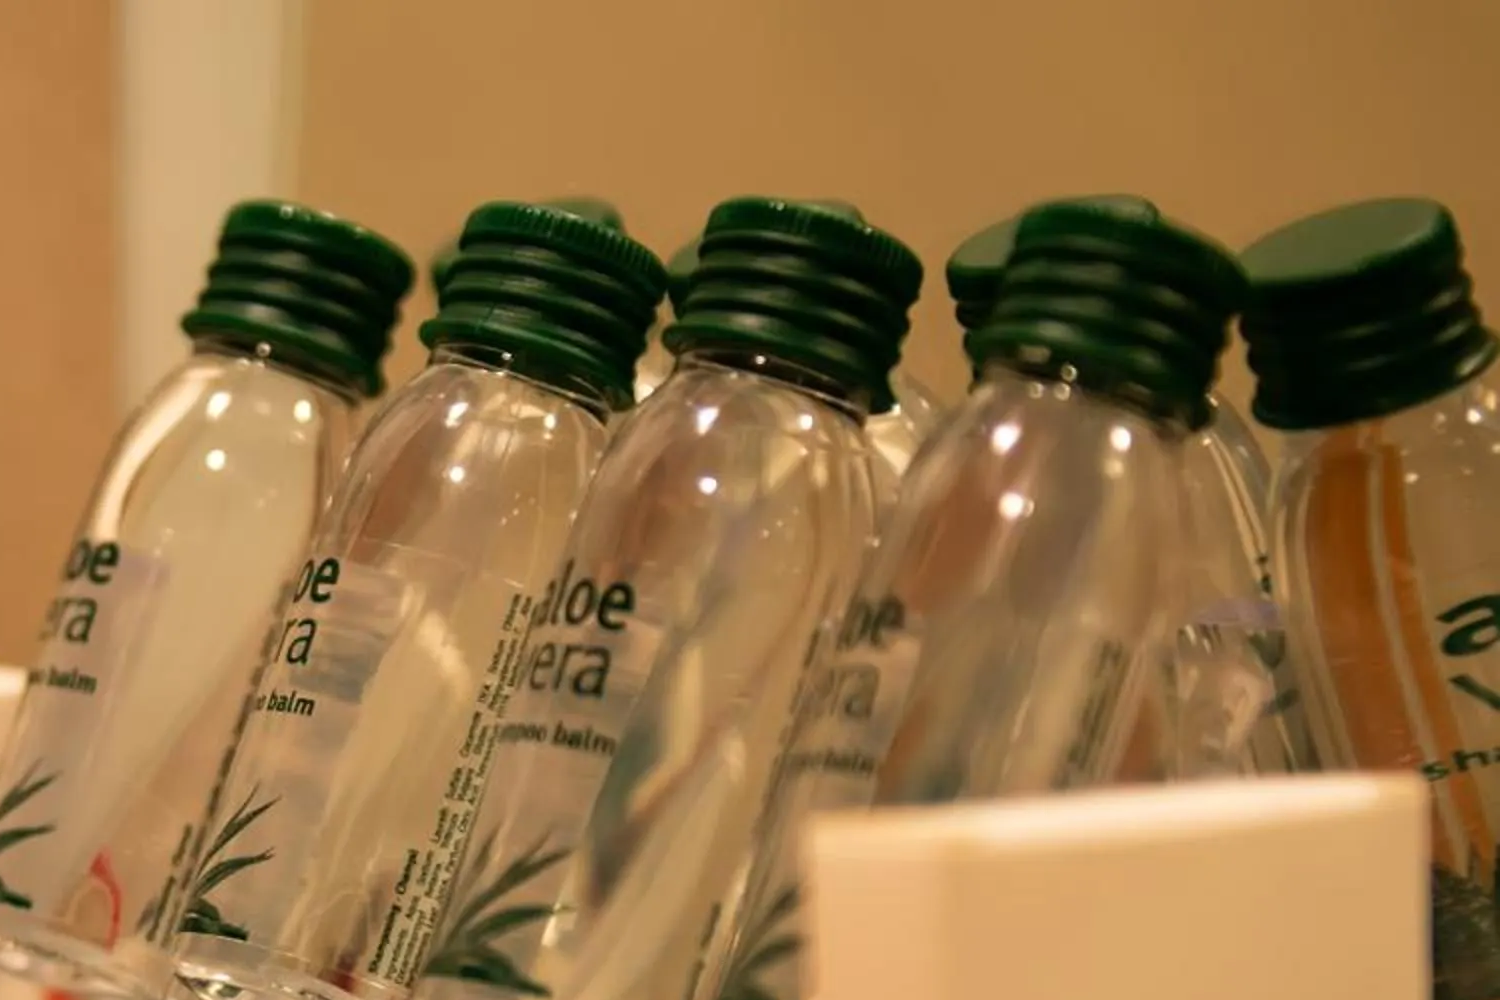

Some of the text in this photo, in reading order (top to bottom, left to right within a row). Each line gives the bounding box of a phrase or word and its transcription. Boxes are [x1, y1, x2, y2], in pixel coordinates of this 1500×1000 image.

[64, 538, 120, 585] oe
[274, 617, 318, 665] ra
[267, 688, 315, 717] balm
